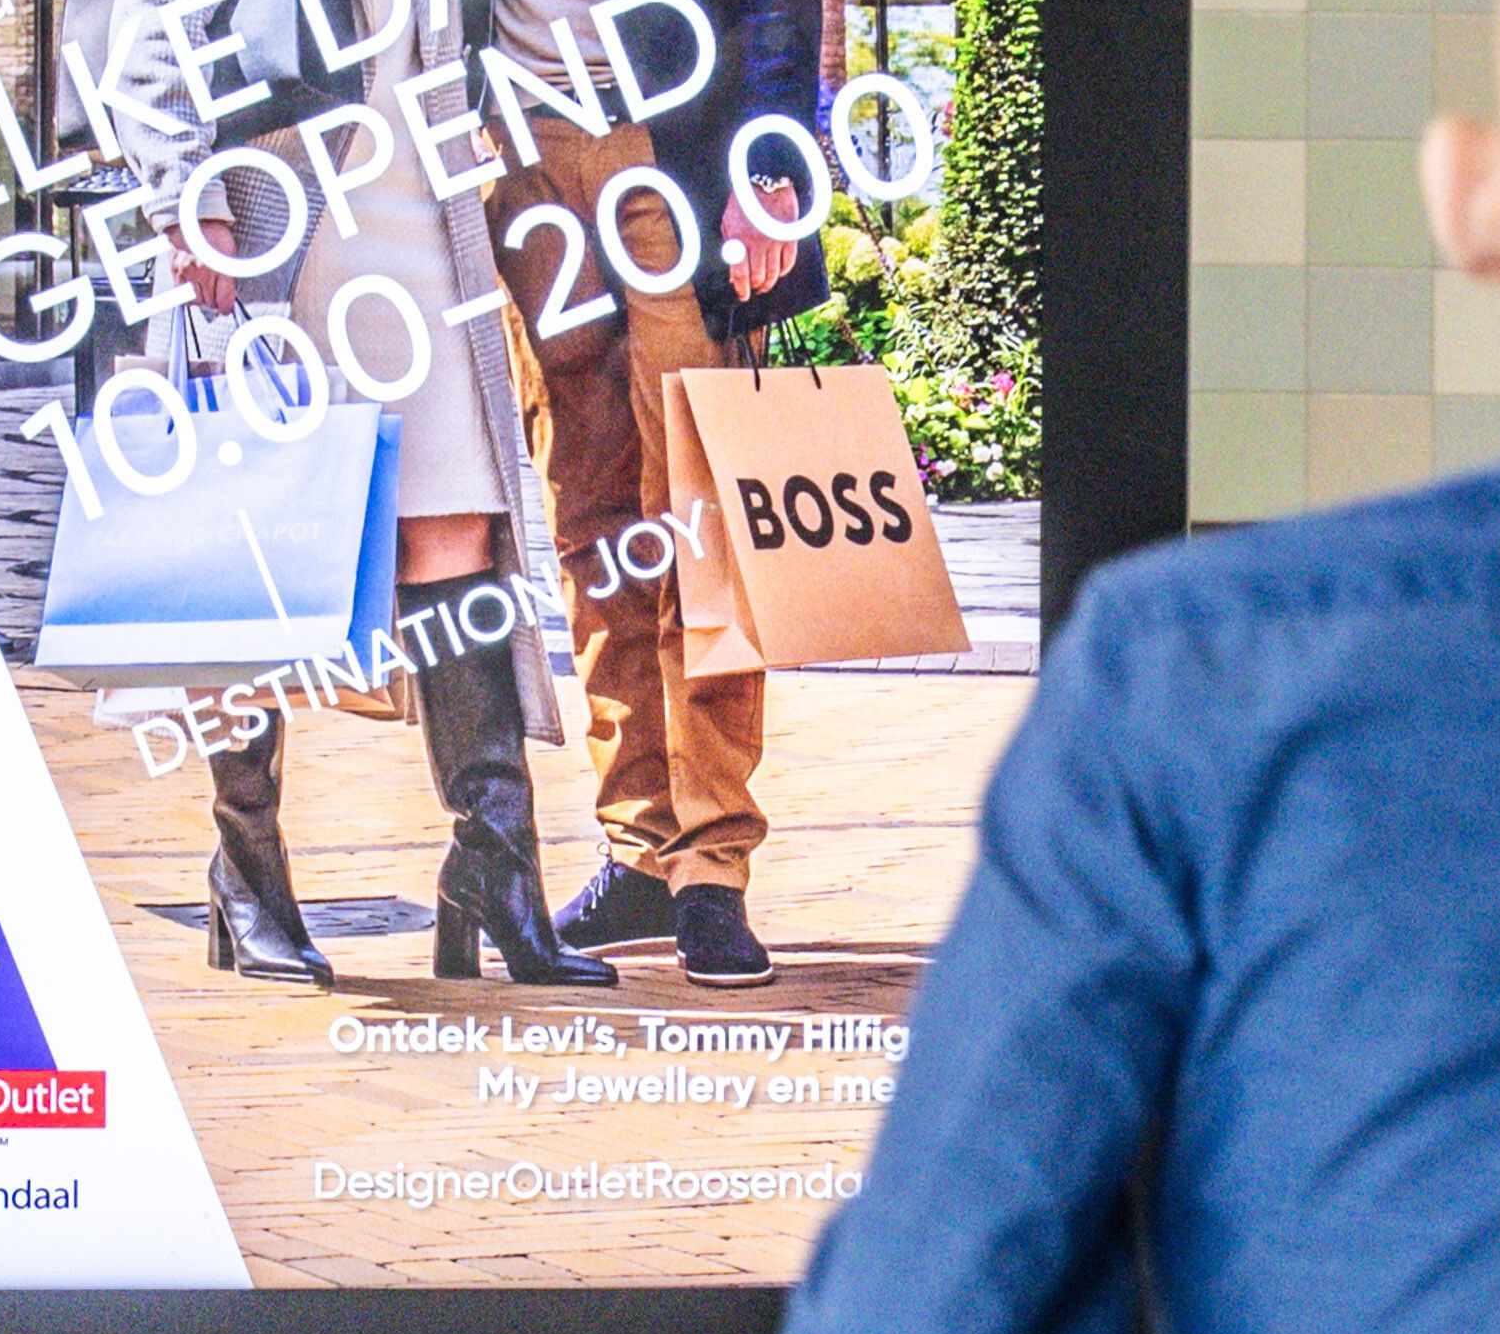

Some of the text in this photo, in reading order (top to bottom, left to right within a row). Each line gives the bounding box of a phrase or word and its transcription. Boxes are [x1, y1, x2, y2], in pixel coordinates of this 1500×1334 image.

[736, 470, 914, 551] BOSS
[134, 500, 706, 779] DESTINATION JOY
[328, 1015, 910, 1062] Ontdek Levi's, Tommy Hilfig
[479, 1068, 540, 1109] My
[553, 1067, 756, 1109] Jewellery
[767, 1075, 821, 1104] en
